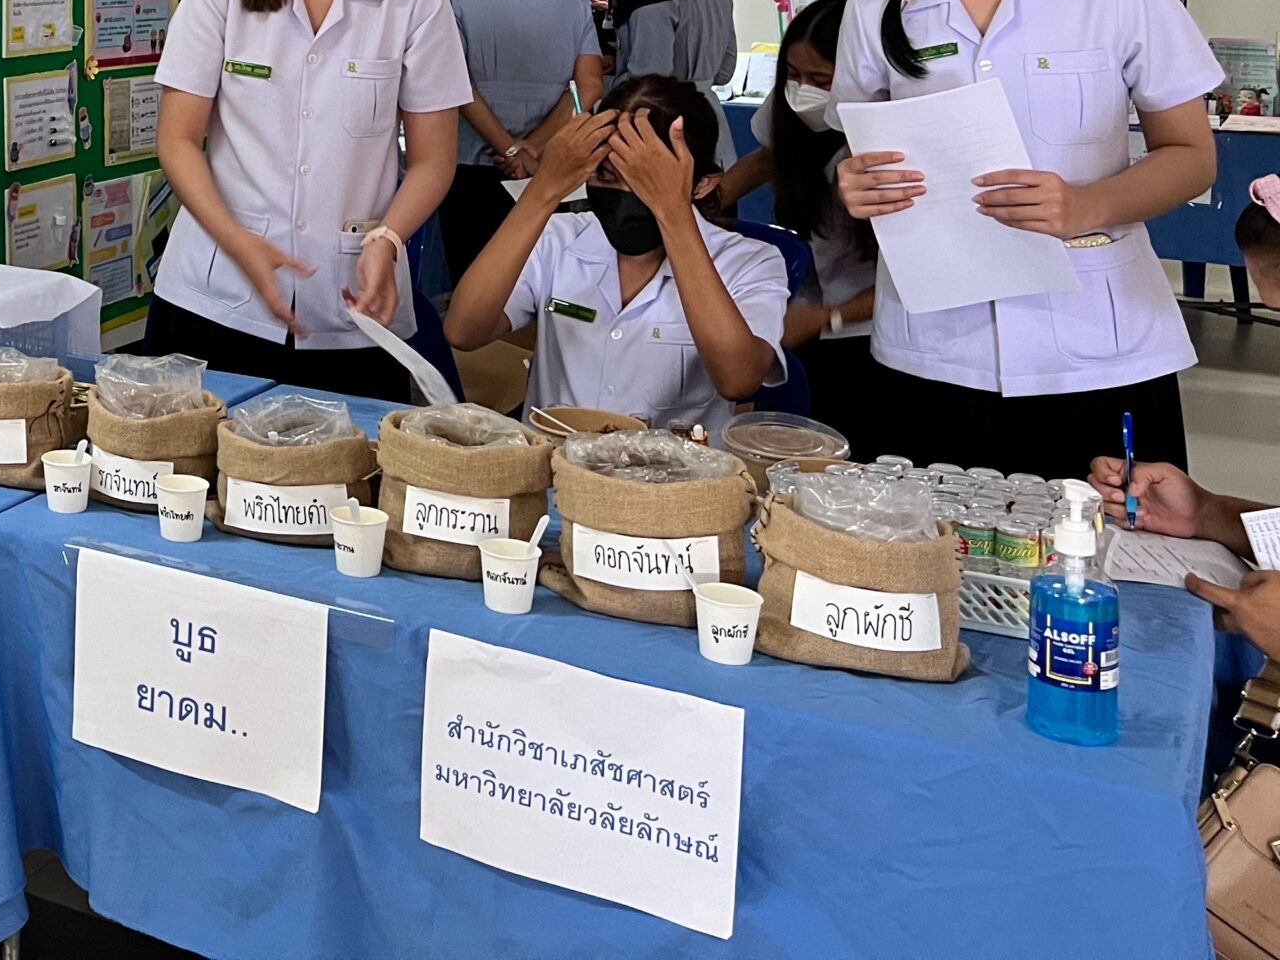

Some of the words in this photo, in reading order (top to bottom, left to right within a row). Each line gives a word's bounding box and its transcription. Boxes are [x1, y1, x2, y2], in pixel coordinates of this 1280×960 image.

[99, 469, 158, 499] รกจันทน์
[244, 495, 327, 526] พริกไทยดำ
[416, 503, 498, 534] ลูกกระวาน
[169, 614, 218, 663] บูธ
[826, 599, 914, 642] ลูกผักชี
[1044, 627, 1096, 645] ALSOFF
[136, 681, 248, 737] ยาดม..
[447, 714, 712, 810] สำนักวิชาเภสัชศาสตร์
[434, 759, 720, 865] มหาวิทยาลัยวลัยลักษณ์
